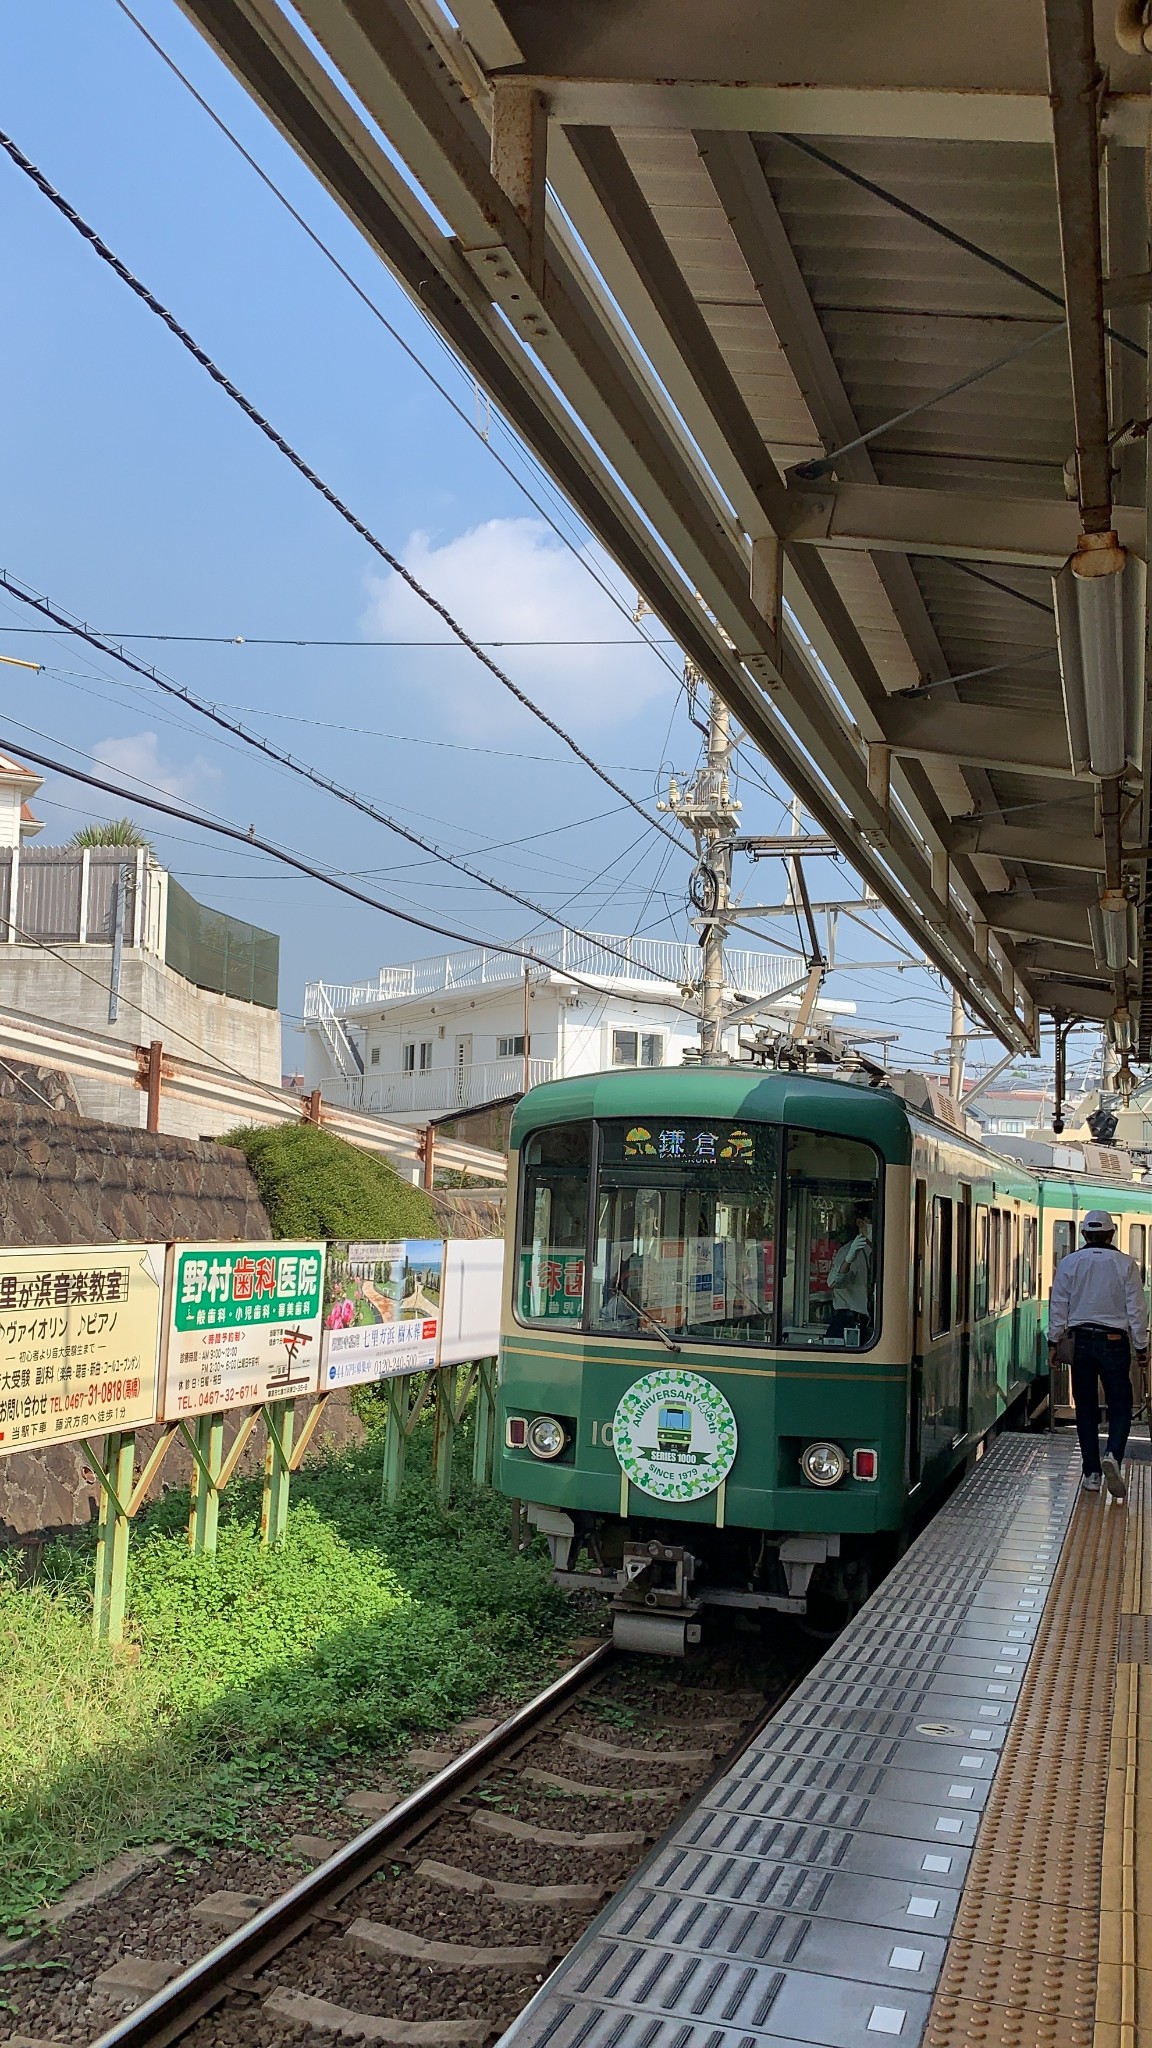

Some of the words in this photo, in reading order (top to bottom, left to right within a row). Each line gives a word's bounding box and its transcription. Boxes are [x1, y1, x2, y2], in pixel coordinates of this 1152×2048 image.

[659, 1129, 719, 1156] 鎌倉
[181, 1255, 318, 1304] 野村歯科医院
[6, 1317, 68, 1344] ヴァイオリン
[87, 1312, 118, 1335] ピアノ
[0, 1369, 31, 1391] 大受験
[35, 1365, 54, 1386] 副科
[633, 1389, 701, 1428] ANNIVERSARY
[651, 1450, 677, 1462] SERIES
[677, 1451, 697, 1464] 1000
[648, 1464, 675, 1480] SINCE
[678, 1468, 698, 1480] 1979
